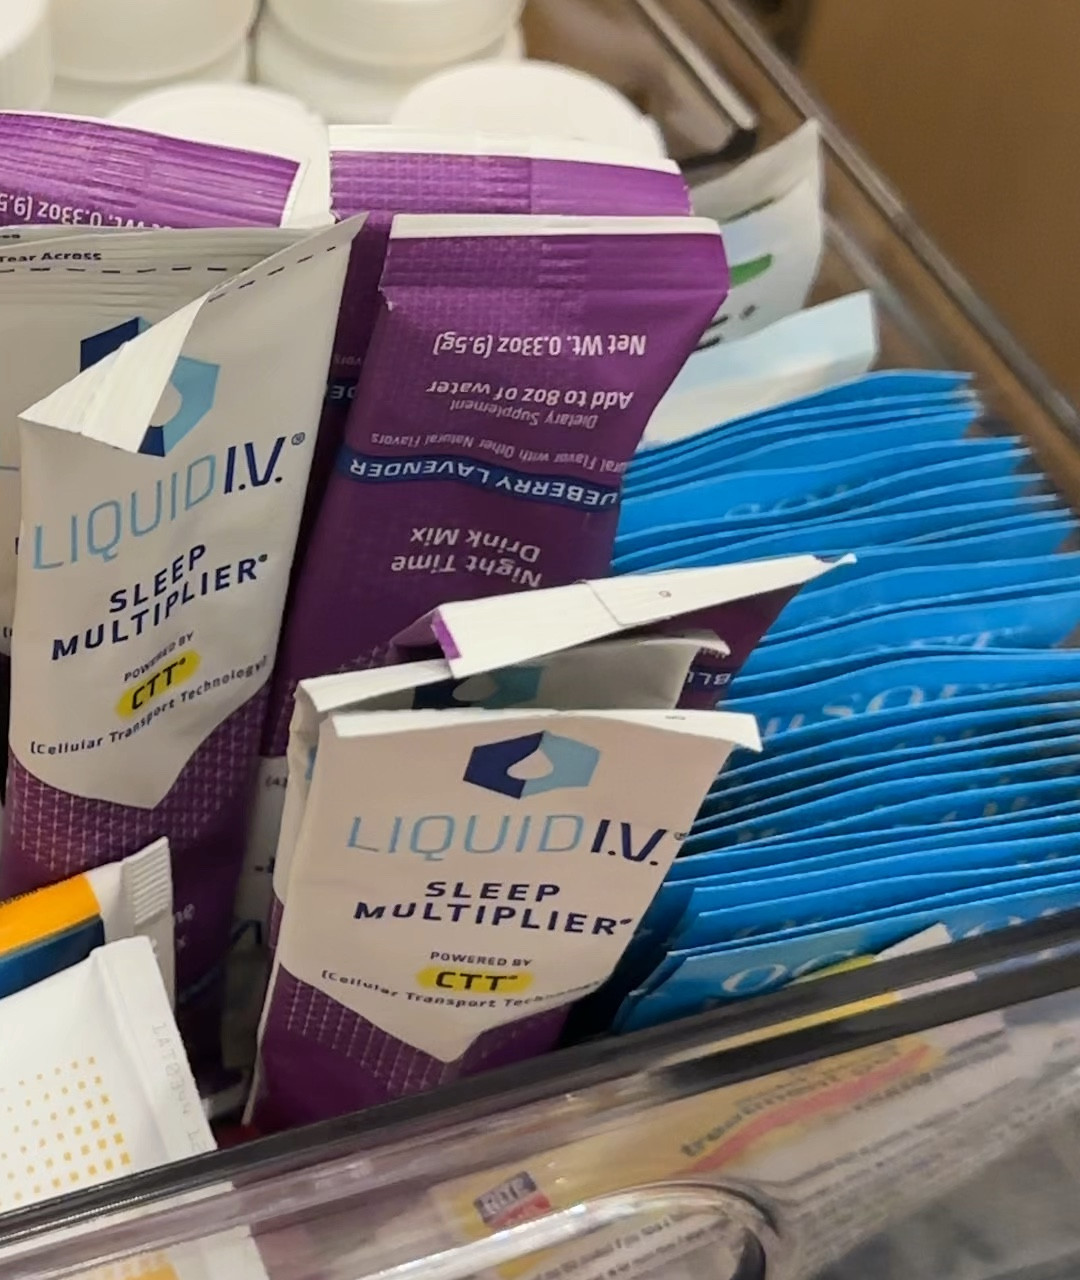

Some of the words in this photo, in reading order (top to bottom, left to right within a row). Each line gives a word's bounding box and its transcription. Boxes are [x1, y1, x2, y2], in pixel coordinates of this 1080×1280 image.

[40, 251, 103, 262] Across
[432, 331, 494, 358] (9.5g)
[496, 333, 562, 356] 0.33oz
[567, 333, 604, 357] Wt.
[607, 333, 647, 357] Net
[425, 379, 492, 398] water
[494, 383, 519, 400] of
[522, 387, 560, 406] 8oz
[563, 389, 587, 407] to
[591, 390, 634, 410] Add
[449, 398, 541, 427] Supplement
[545, 410, 599, 430] Dietary
[349, 457, 489, 485] LAVENDER
[32, 454, 218, 571] LIQUID
[409, 526, 461, 547] Mix
[467, 528, 542, 564] Drink
[390, 554, 457, 574] Time
[466, 554, 543, 588] Night
[108, 542, 208, 614] SLEEP
[123, 641, 177, 684] POWERED
[177, 630, 195, 649] BY
[108, 697, 176, 745] Transport
[346, 814, 586, 862] LIQUID
[424, 881, 561, 904] SLEEP
[429, 951, 508, 967] POWERED
